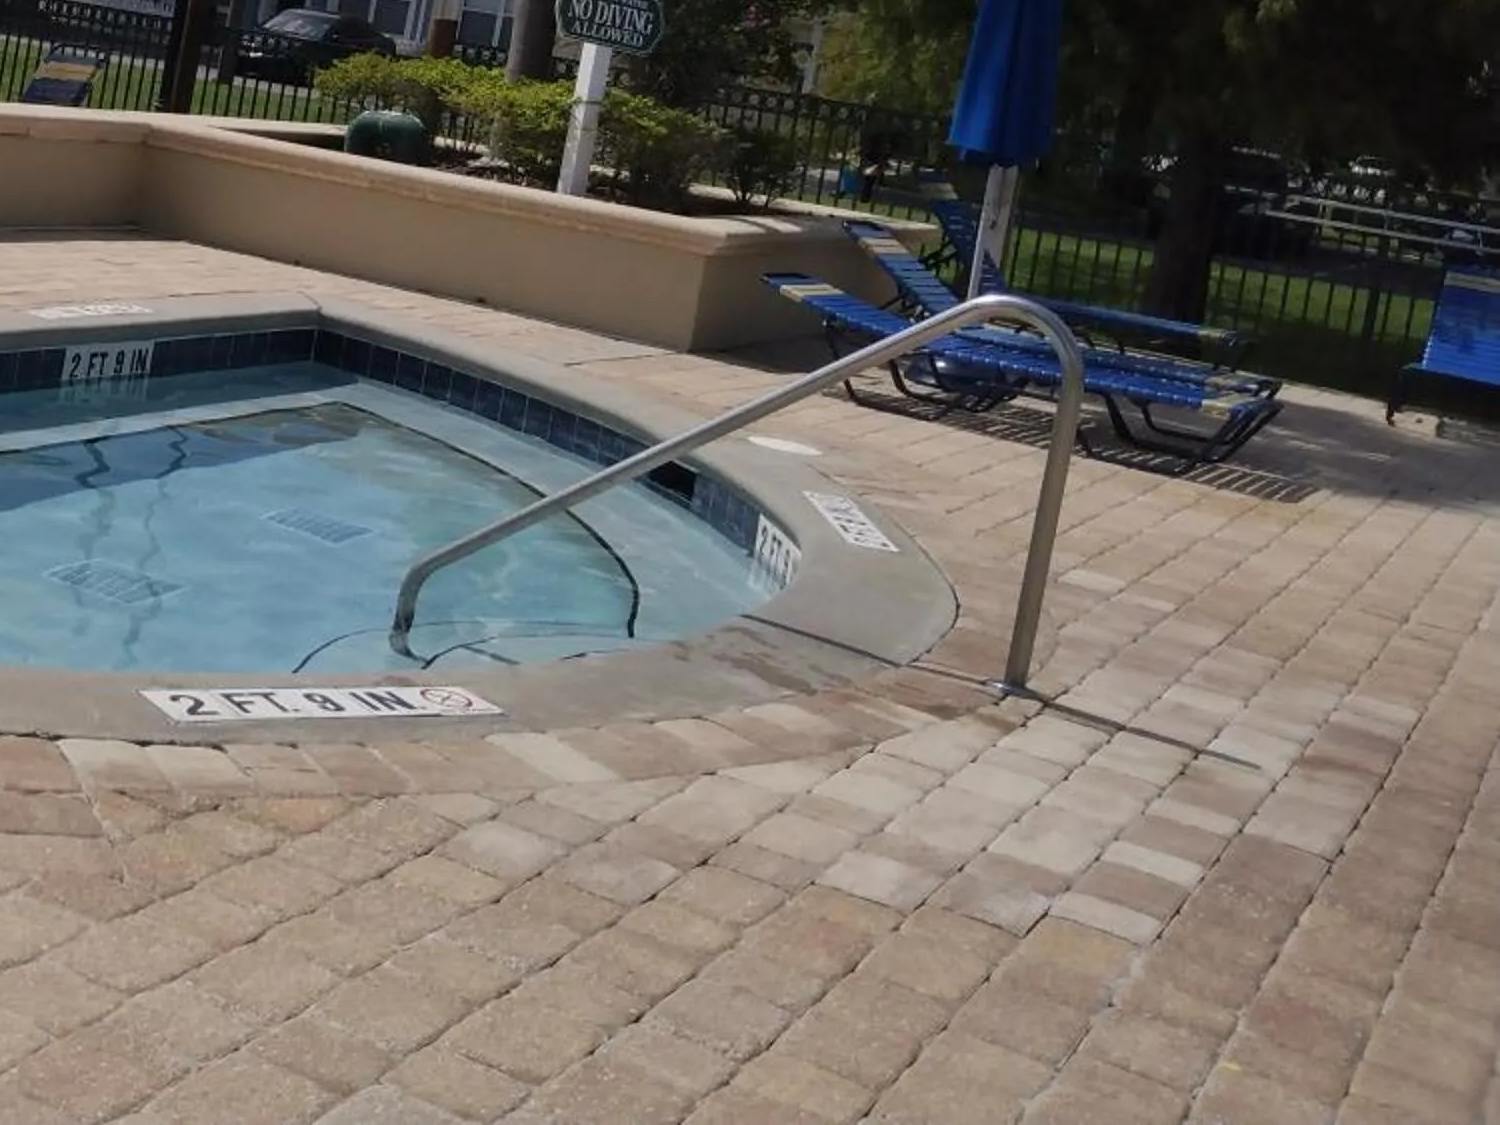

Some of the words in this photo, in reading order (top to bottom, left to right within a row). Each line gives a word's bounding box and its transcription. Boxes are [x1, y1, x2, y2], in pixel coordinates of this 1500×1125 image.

[594, 0, 653, 36] DIVING
[571, 20, 644, 48] ALLOWED
[69, 353, 83, 379] 2
[87, 352, 109, 376] FT
[113, 350, 125, 373] 9
[129, 347, 149, 373] IN
[170, 694, 219, 716] 2
[303, 692, 346, 712] 9
